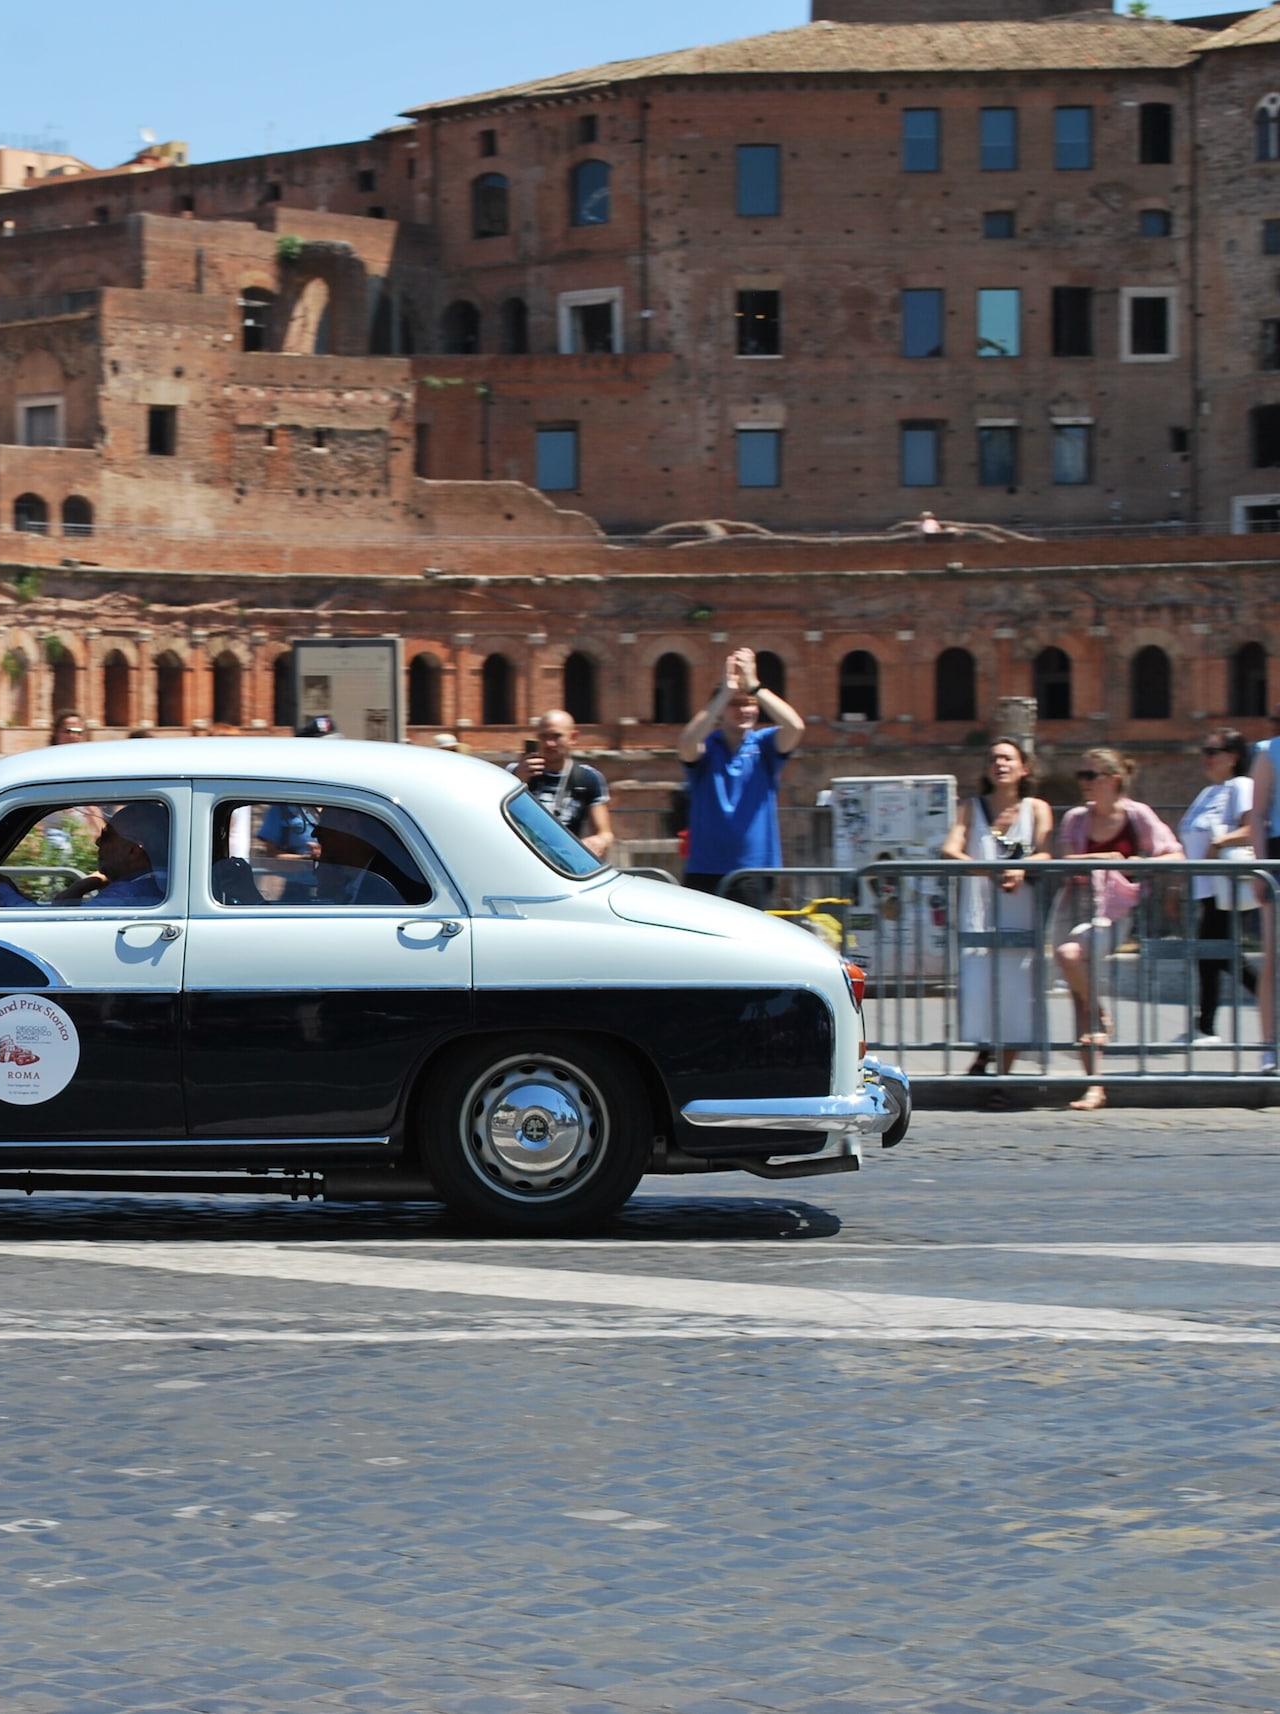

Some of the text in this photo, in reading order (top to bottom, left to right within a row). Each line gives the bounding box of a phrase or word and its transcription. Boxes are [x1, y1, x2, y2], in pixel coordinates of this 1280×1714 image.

[20, 1000, 43, 1012] Prix
[43, 1007, 70, 1041] Storico
[7, 1071, 40, 1079] ROMA
